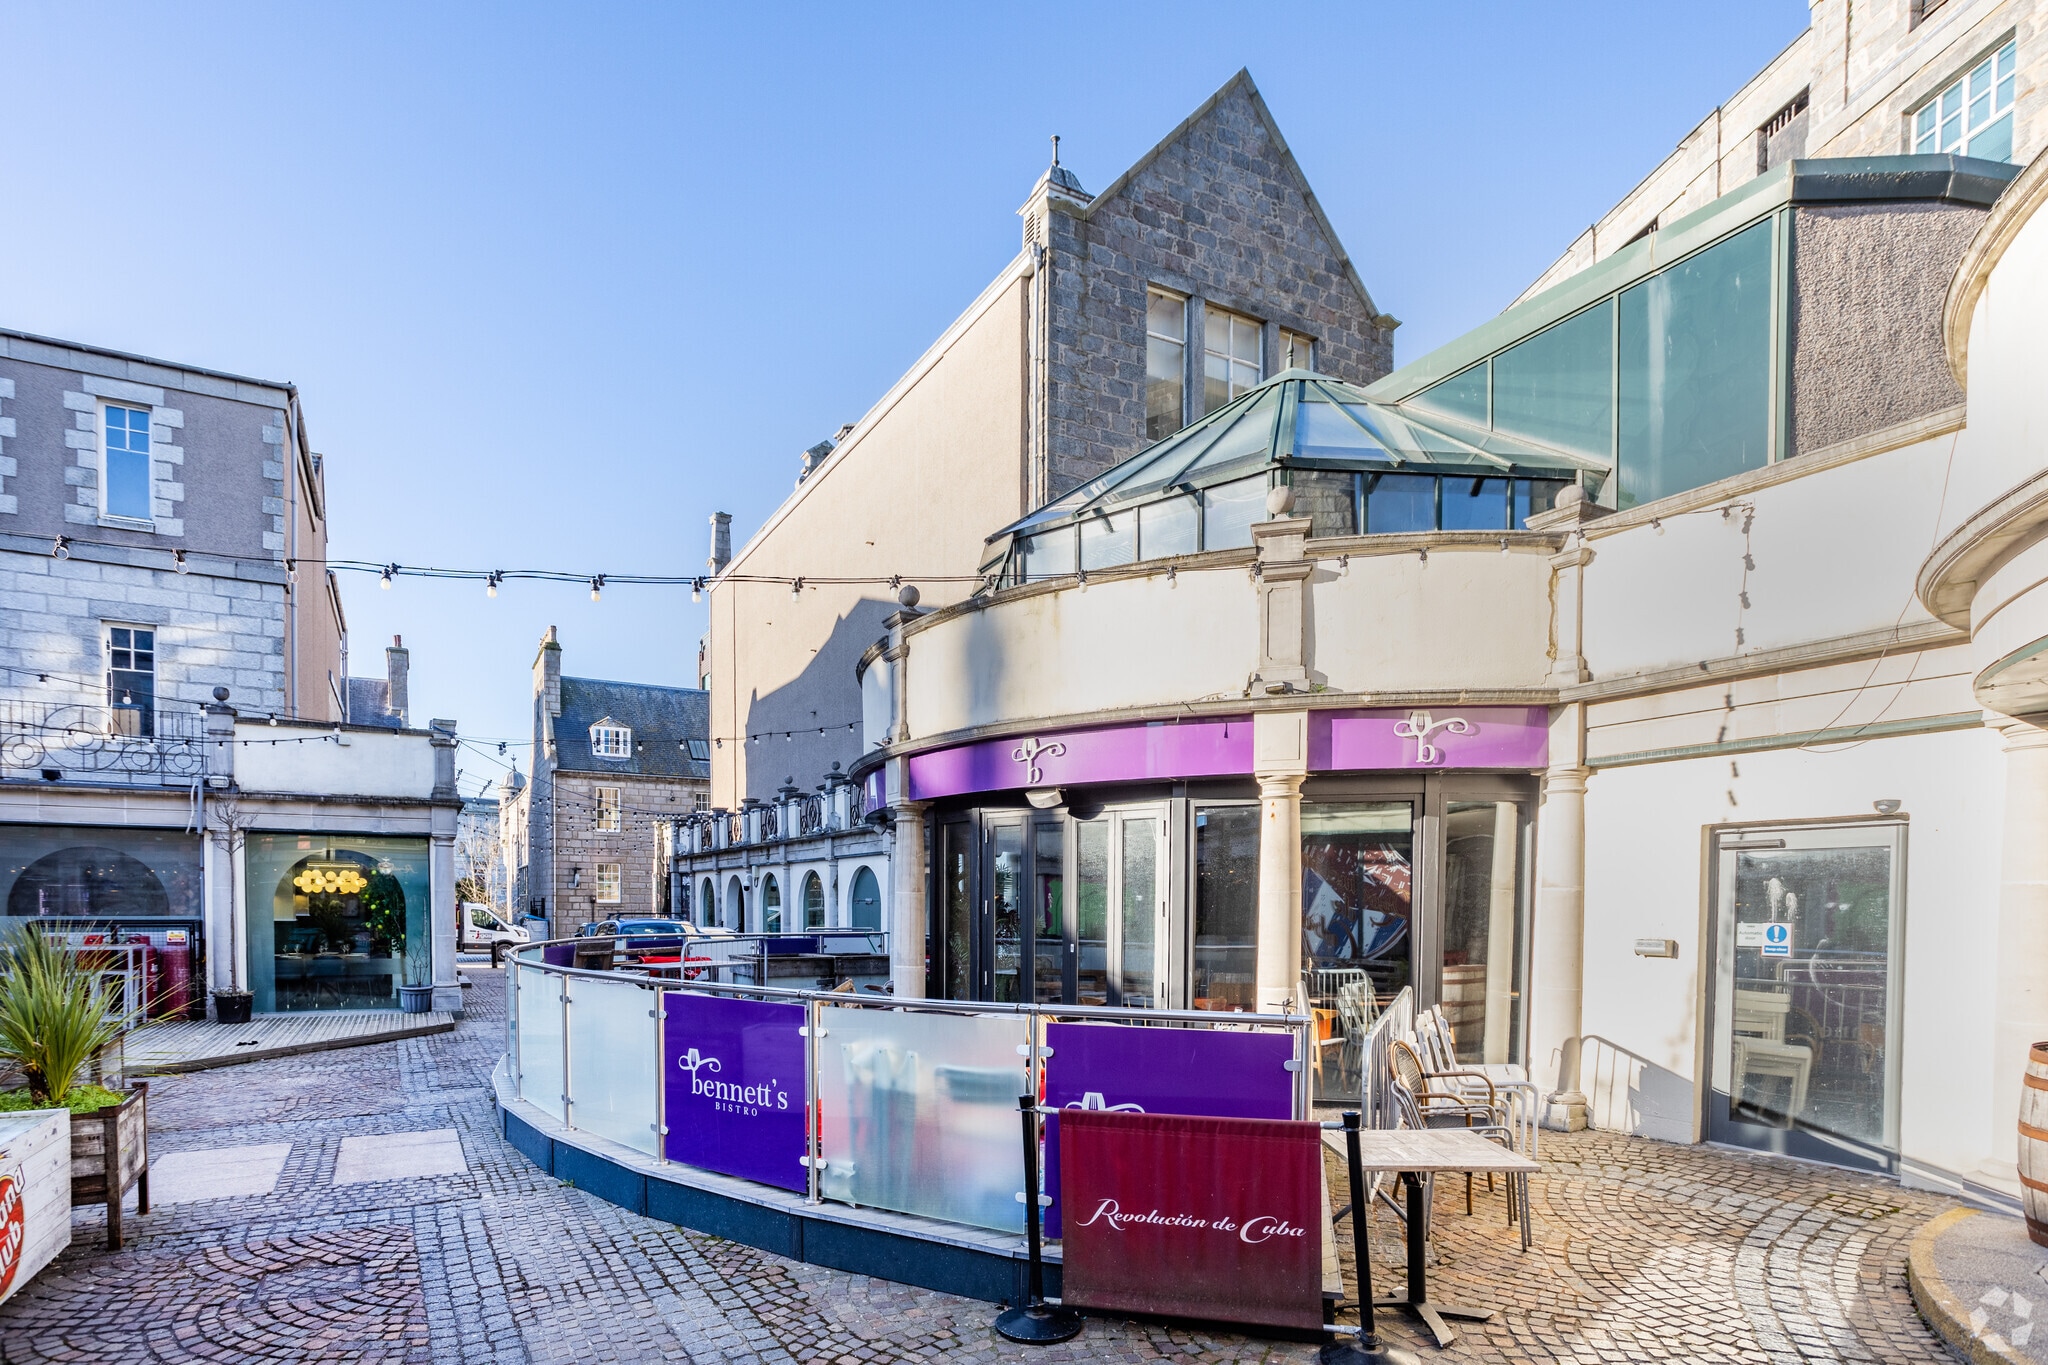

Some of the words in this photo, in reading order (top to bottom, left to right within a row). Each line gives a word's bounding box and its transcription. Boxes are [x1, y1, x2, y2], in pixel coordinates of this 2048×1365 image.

[682, 1060, 788, 1110] bennett's
[715, 1101, 758, 1117] BISTRO
[1075, 1198, 1210, 1231] Revolución
[1212, 1216, 1239, 1232] de
[1239, 1216, 1307, 1244] Cuba
